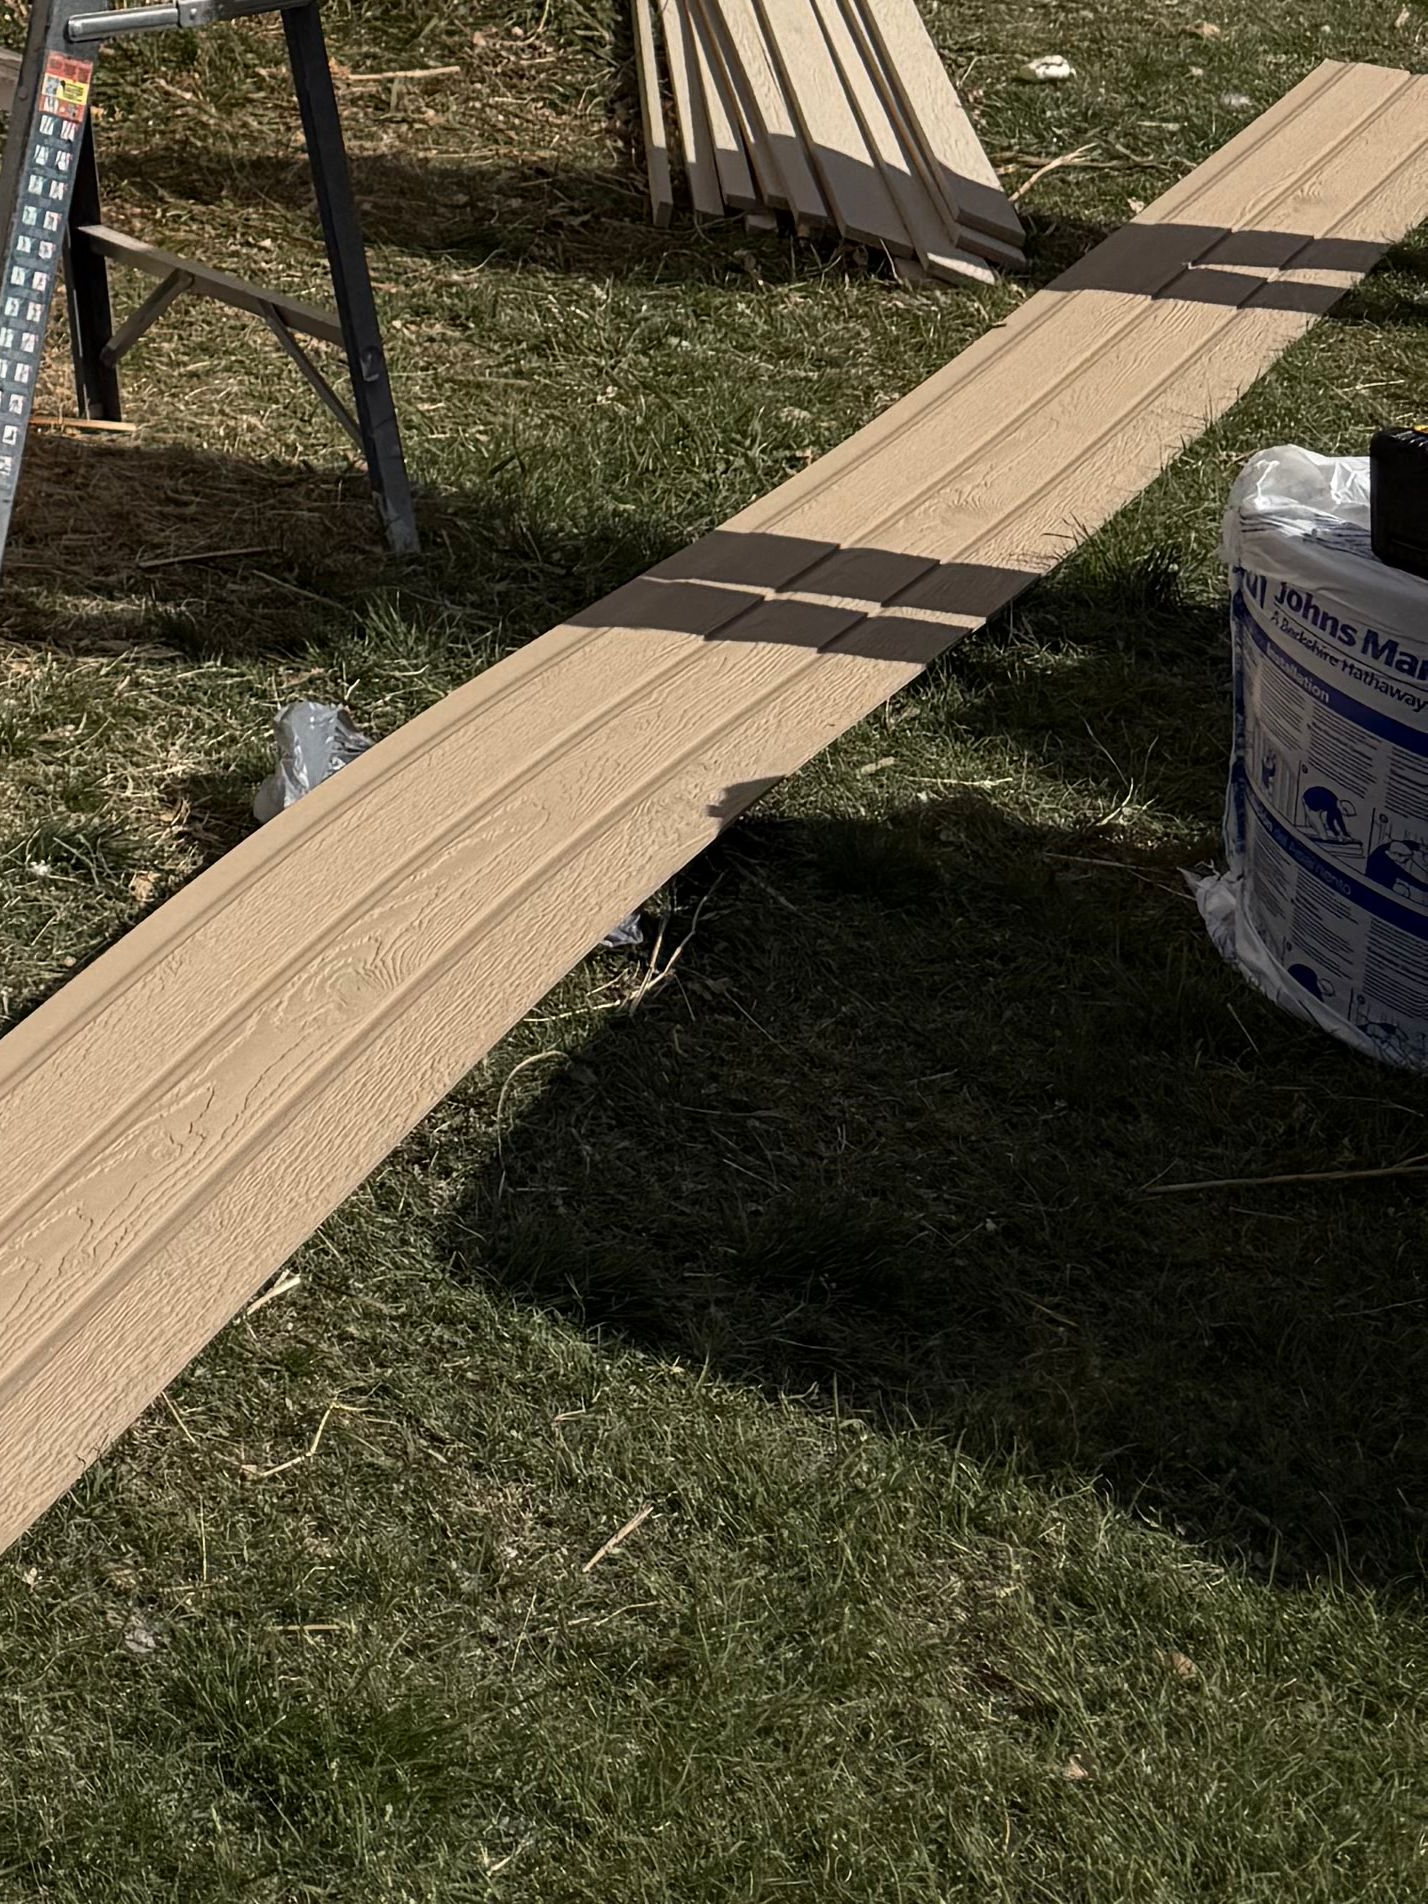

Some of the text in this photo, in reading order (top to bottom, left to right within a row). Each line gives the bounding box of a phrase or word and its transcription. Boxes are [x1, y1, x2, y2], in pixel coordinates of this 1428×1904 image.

[1274, 581, 1358, 647] Johns
[1269, 610, 1279, 626] A
[1341, 658, 1428, 713] Hathaway
